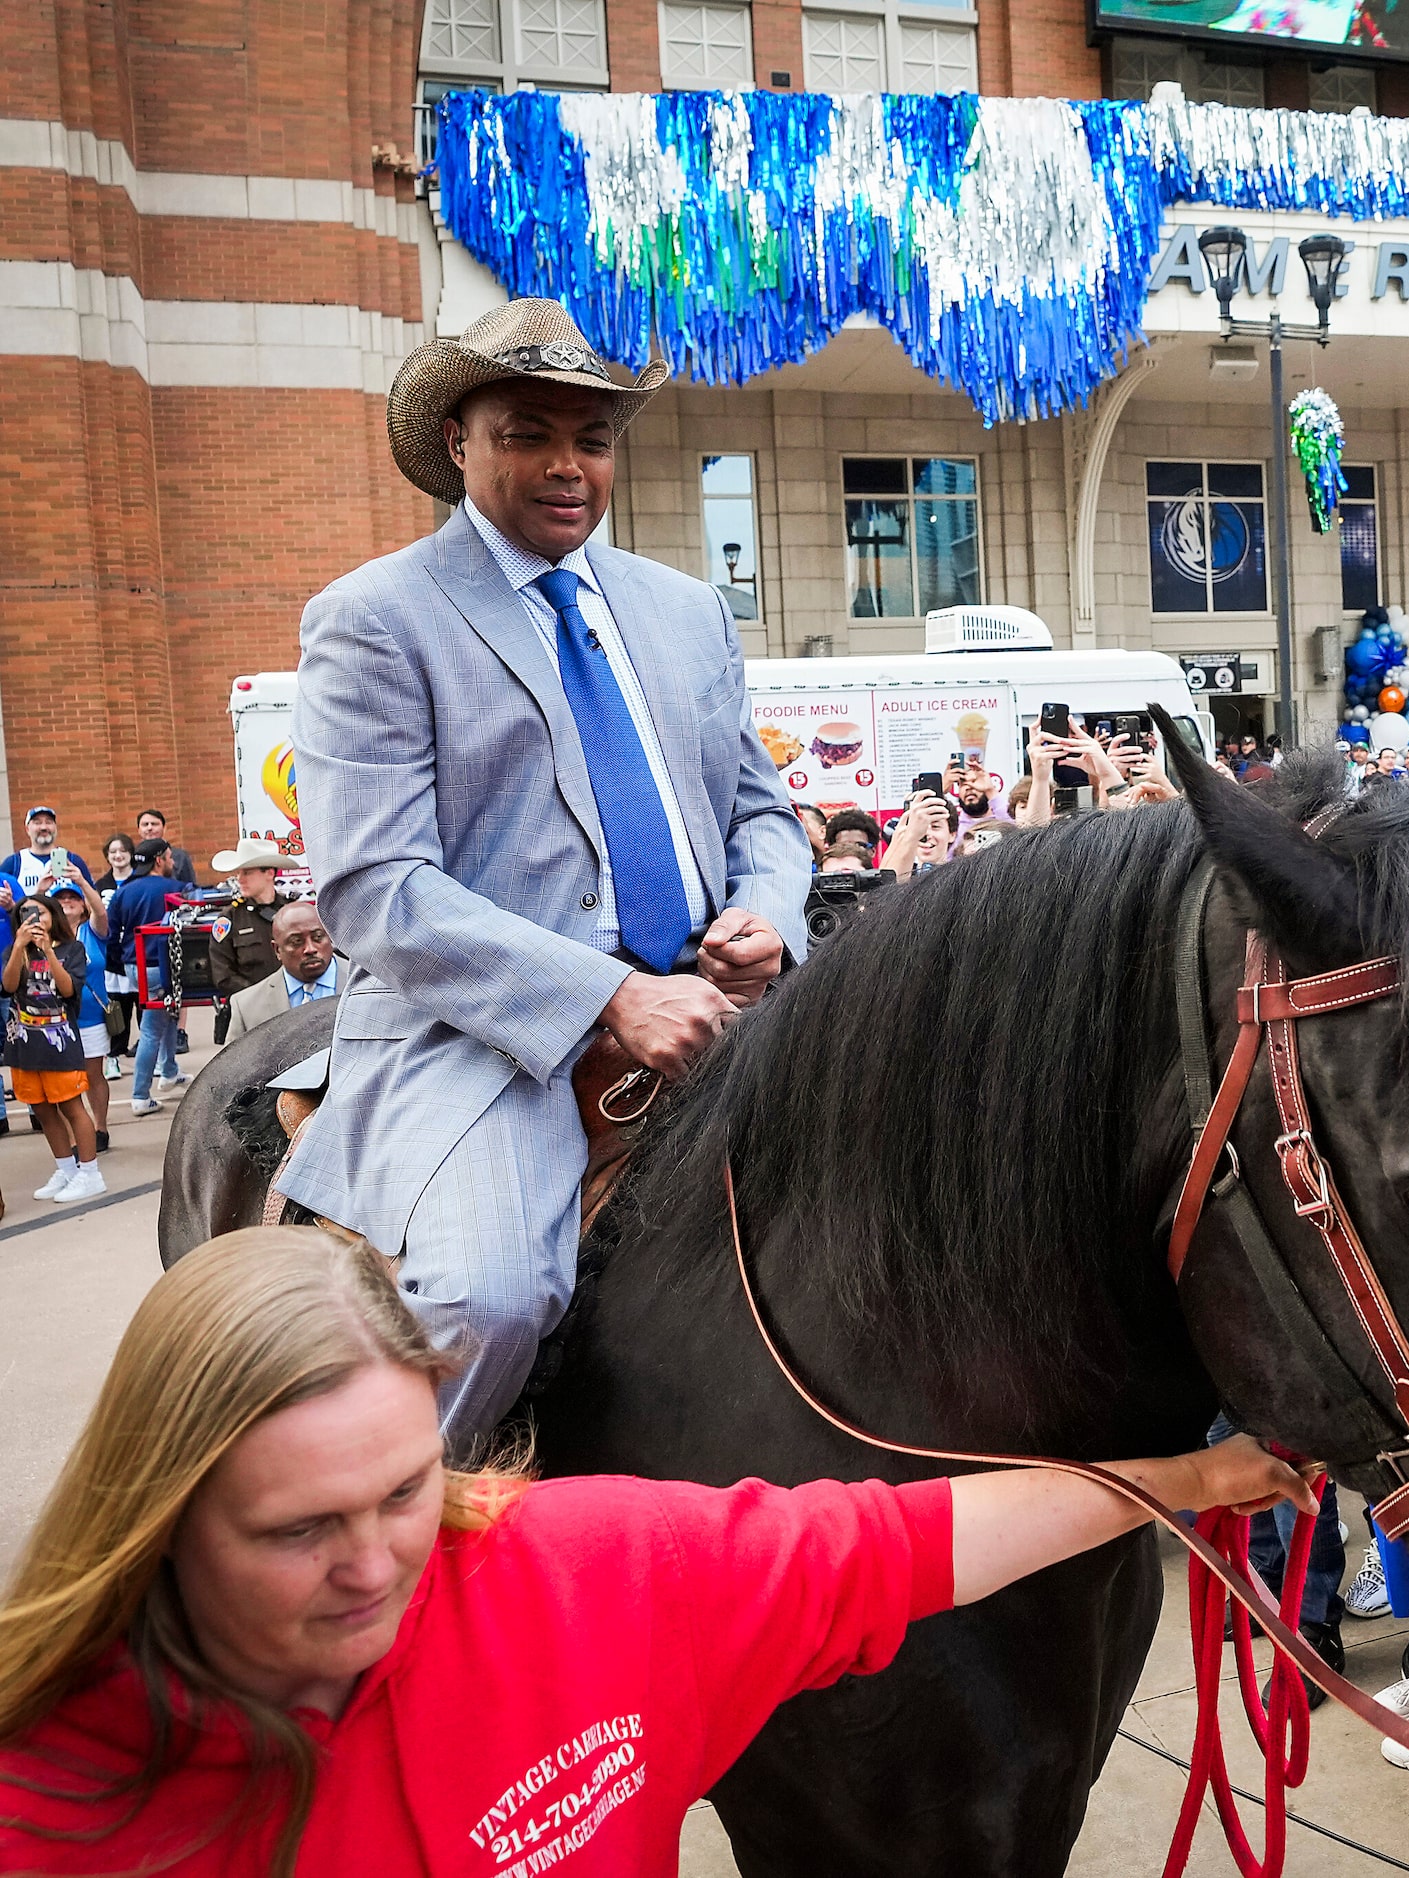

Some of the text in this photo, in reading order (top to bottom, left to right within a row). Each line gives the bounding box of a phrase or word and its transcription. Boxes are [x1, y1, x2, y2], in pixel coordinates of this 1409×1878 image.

[754, 704, 849, 718] FOODIE MENU
[881, 698, 998, 713] ADULT ICE CREAM
[468, 1754, 558, 1850] VINTAGE
